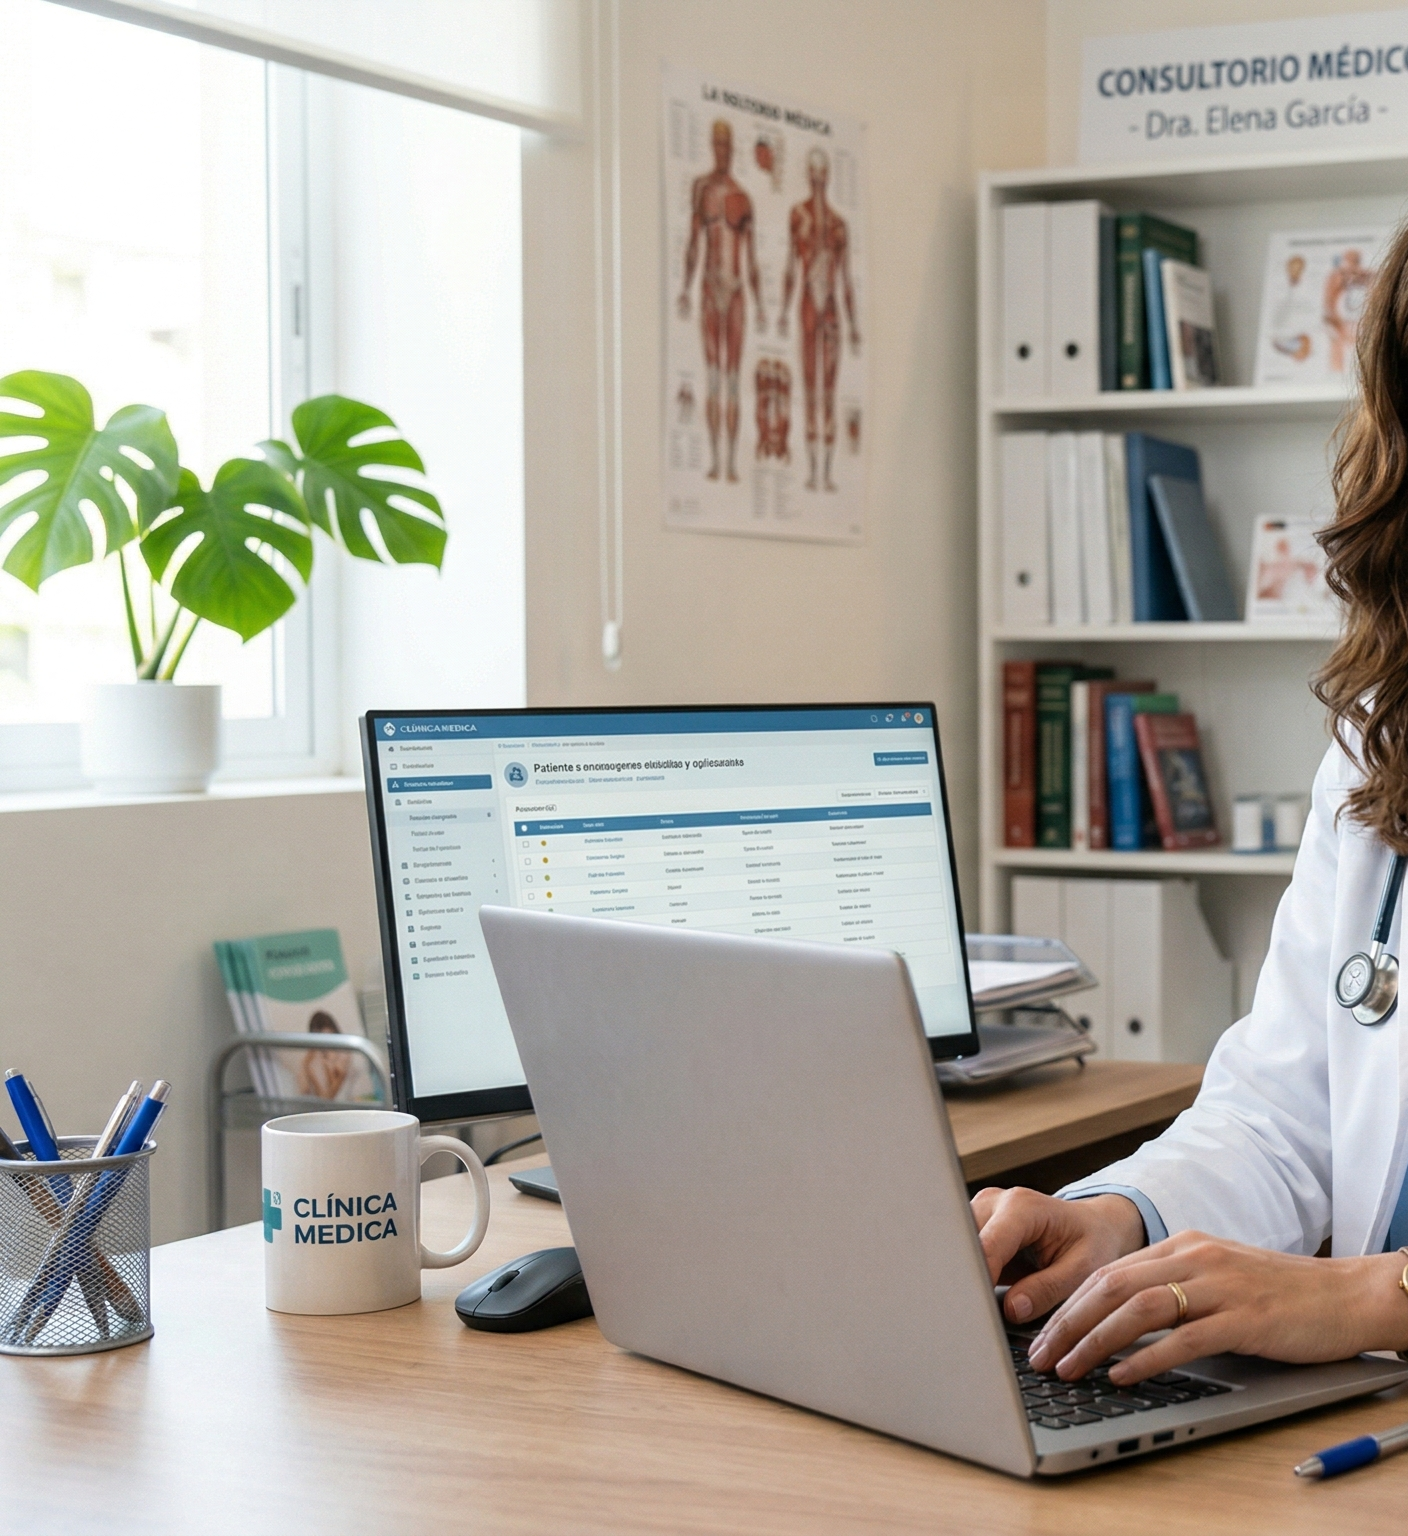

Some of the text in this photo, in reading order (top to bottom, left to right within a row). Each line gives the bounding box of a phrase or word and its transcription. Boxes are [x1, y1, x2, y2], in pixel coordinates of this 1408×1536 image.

[1097, 56, 1300, 98] CONSULTORIO
[1146, 111, 1198, 140] Dra.
[1206, 104, 1277, 135] Elena
[1285, 94, 1370, 129] García
[533, 762, 574, 773] Patiente
[293, 1192, 398, 1245] CLÍNICA MEDICA
